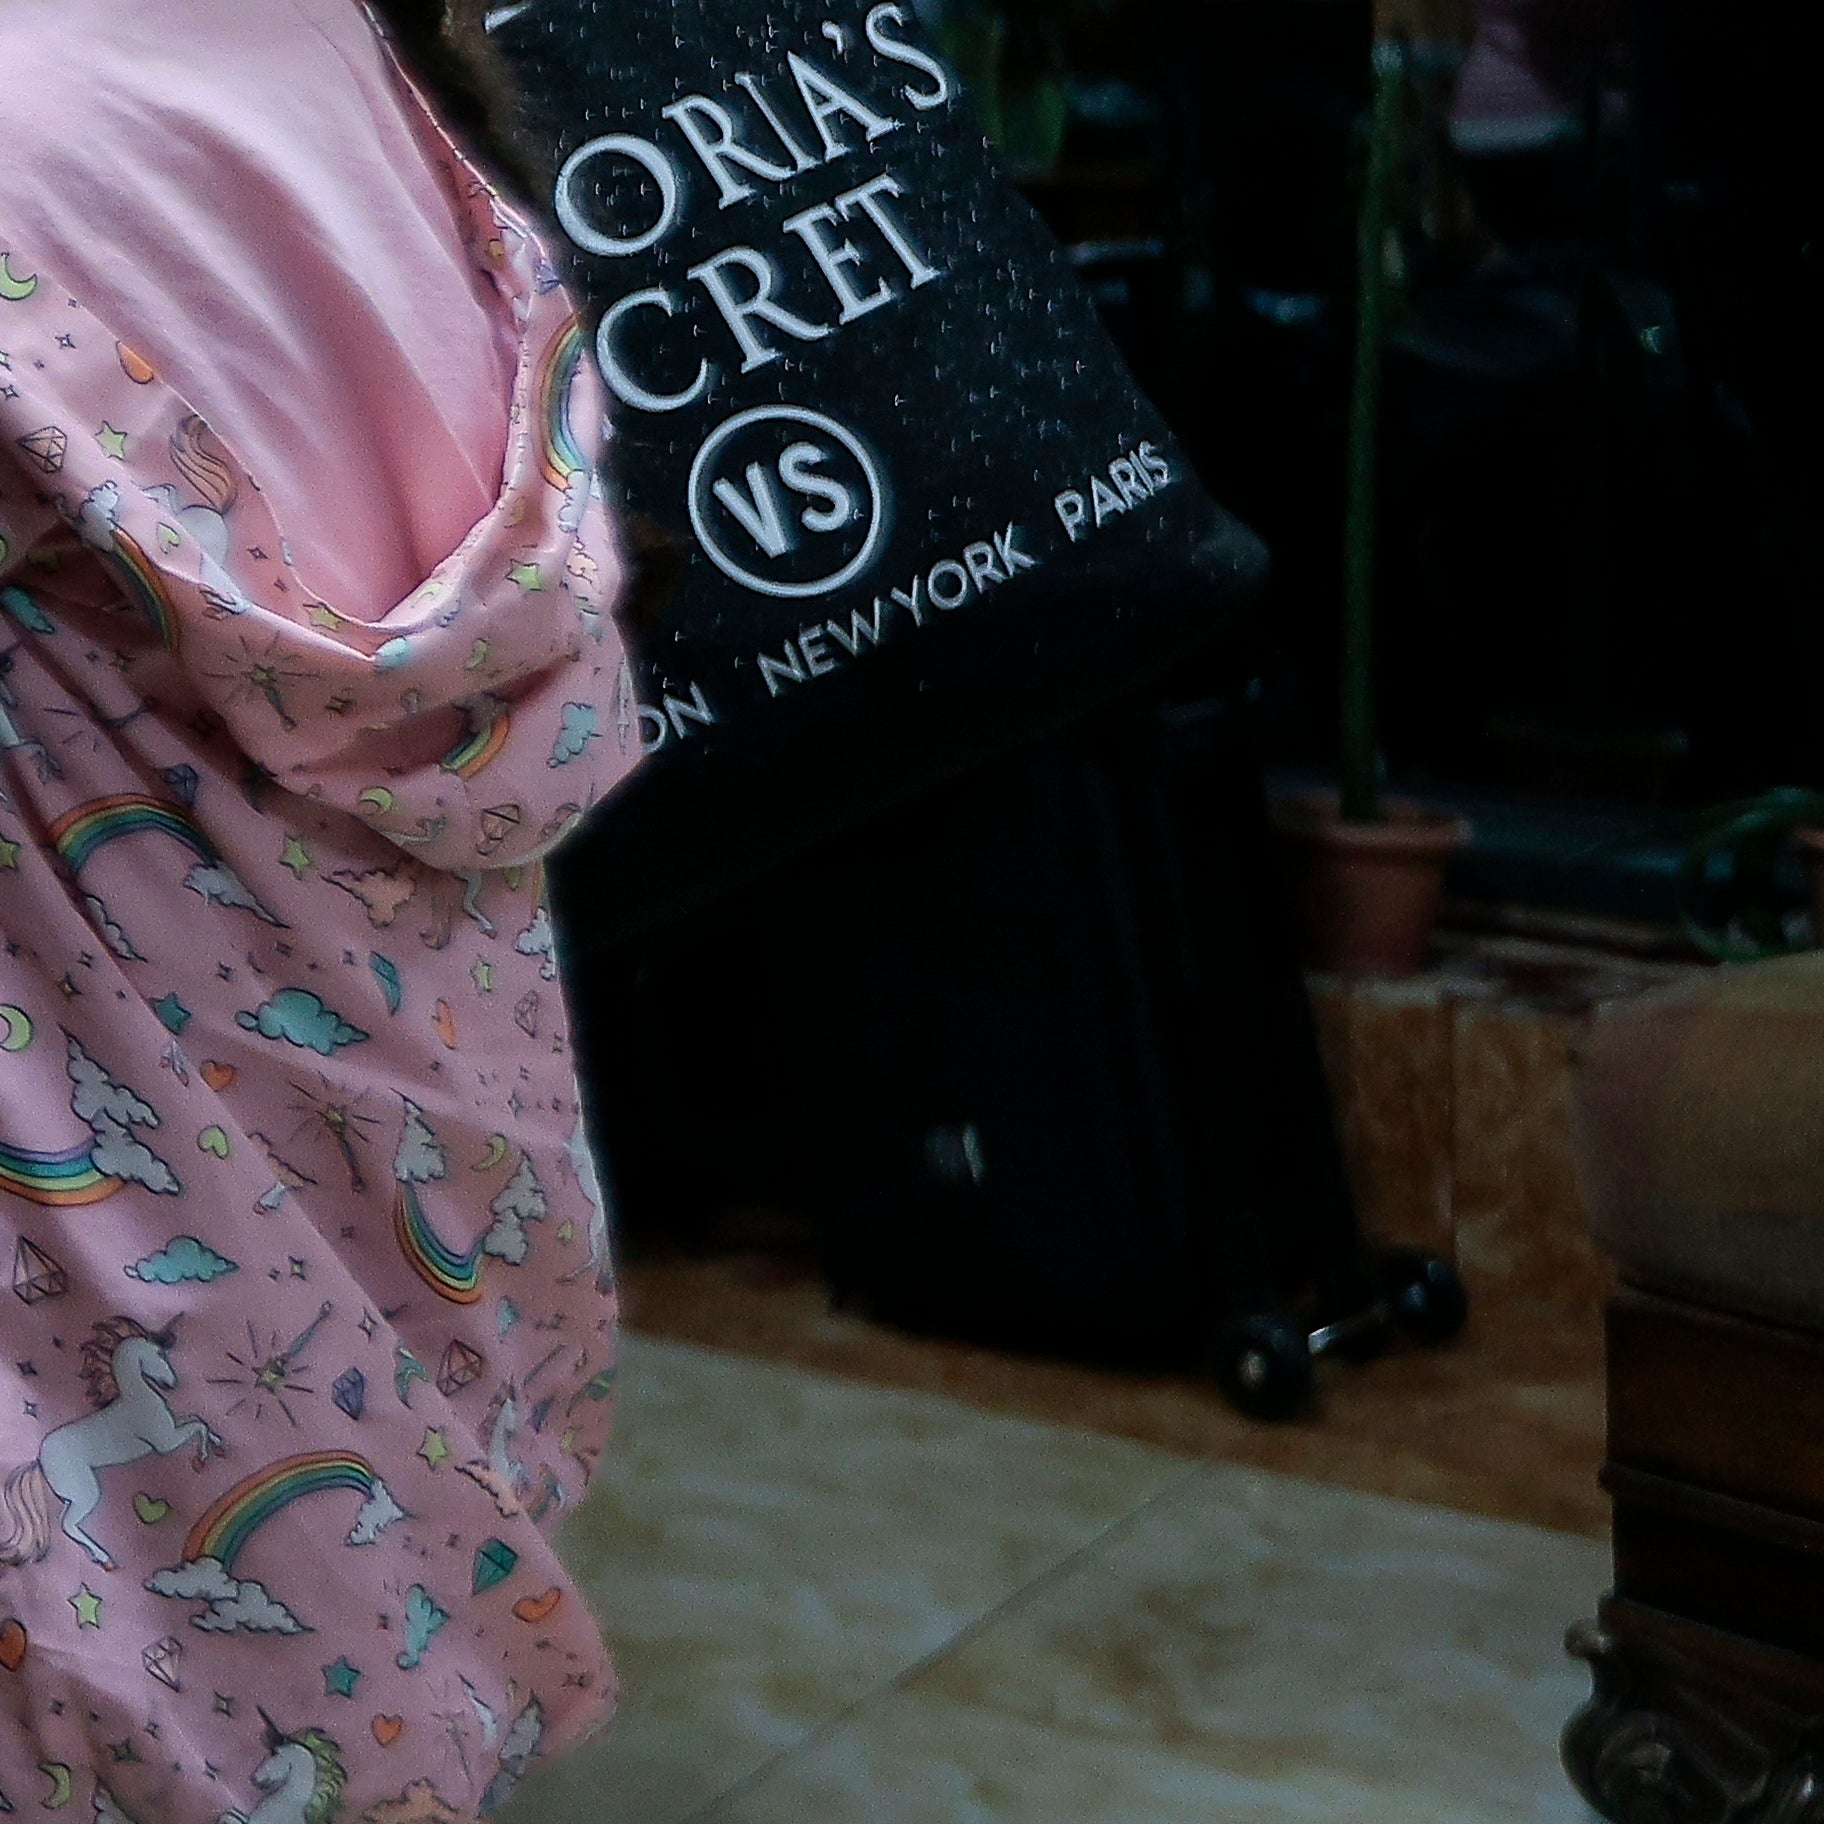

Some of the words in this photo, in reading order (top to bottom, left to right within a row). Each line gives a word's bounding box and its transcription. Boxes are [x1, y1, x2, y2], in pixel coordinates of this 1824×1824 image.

[554, 1, 950, 258] ORIA'S
[596, 172, 942, 413] CRET
[712, 441, 852, 559] VS
[756, 596, 884, 699] NEW
[890, 521, 1036, 627] YORK
[1053, 439, 1172, 543] PARIS
